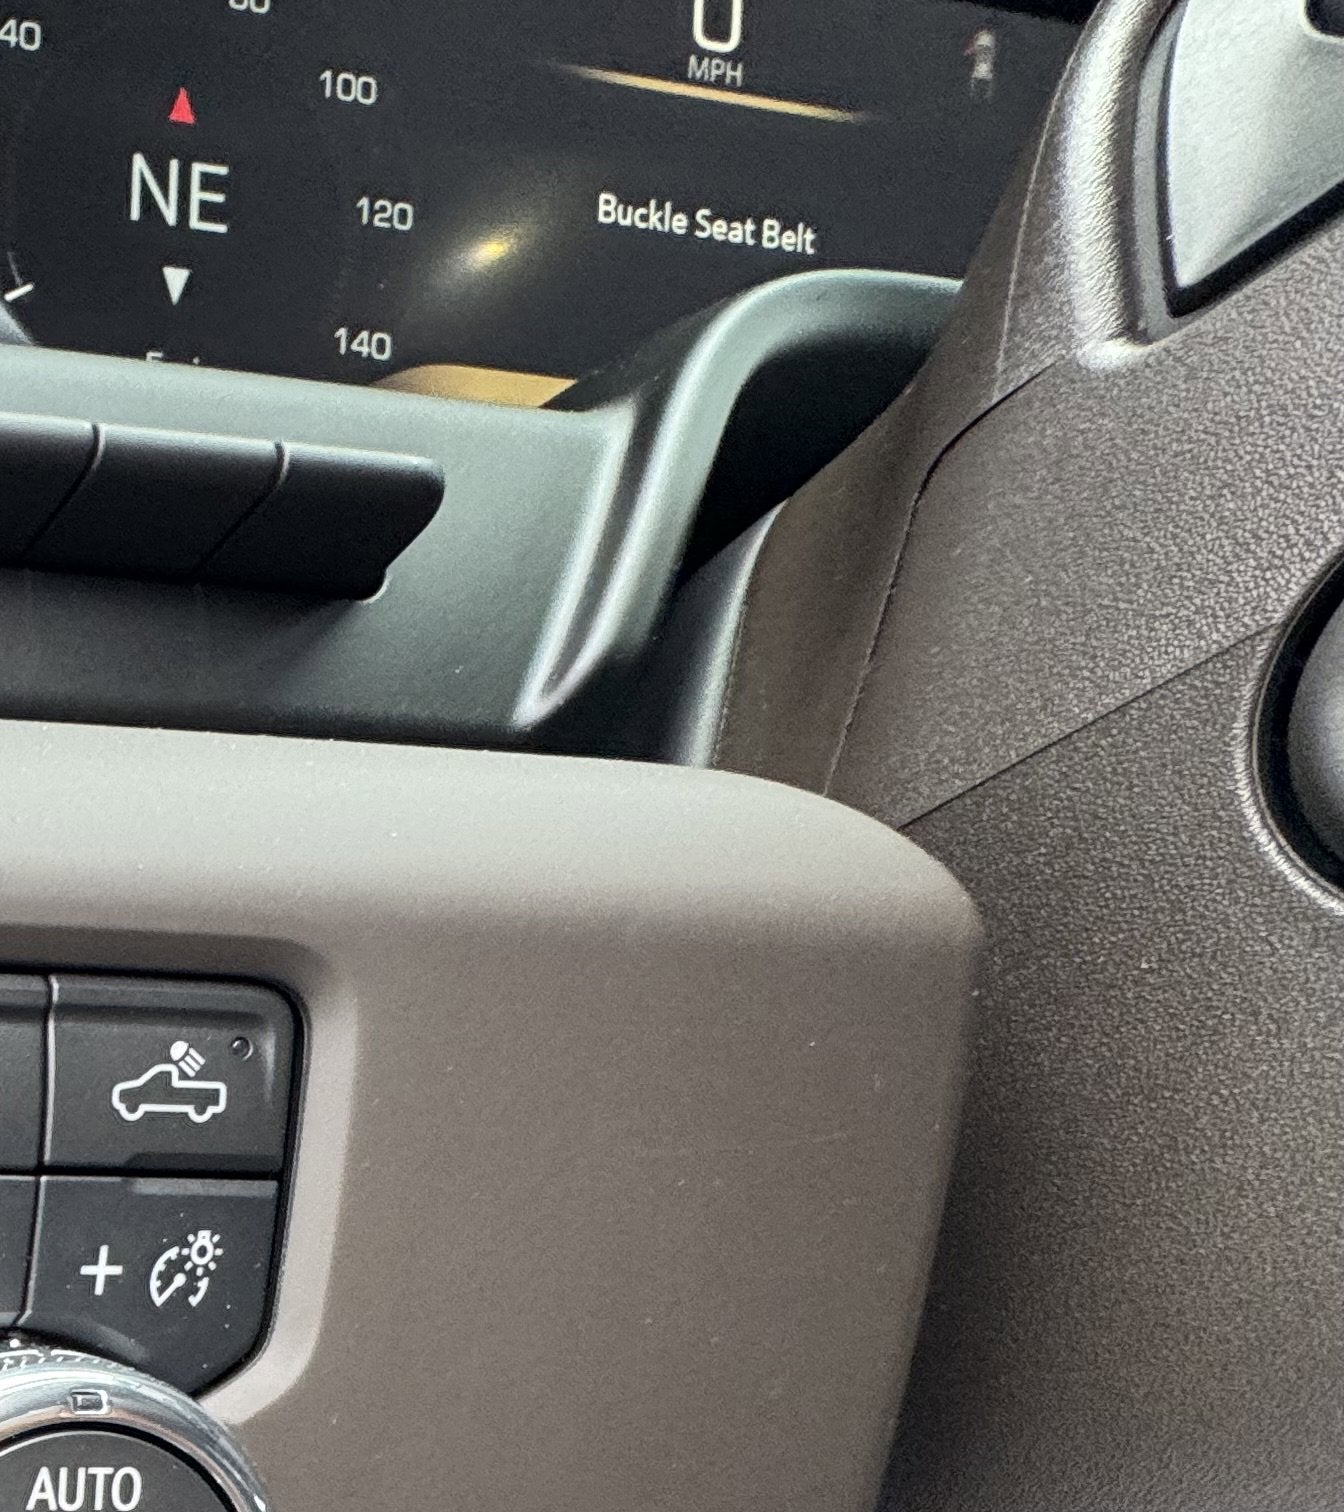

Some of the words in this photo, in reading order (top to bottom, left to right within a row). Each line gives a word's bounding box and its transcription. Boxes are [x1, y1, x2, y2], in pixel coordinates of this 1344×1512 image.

[319, 69, 379, 106] 100
[687, 54, 743, 87] MPH
[129, 152, 230, 234] NE
[356, 196, 414, 231] 120
[597, 191, 689, 235] Buckle
[694, 208, 756, 246] Seat
[761, 217, 817, 255] Belt
[333, 327, 392, 361] 140
[25, 1466, 143, 1512] AUTO
